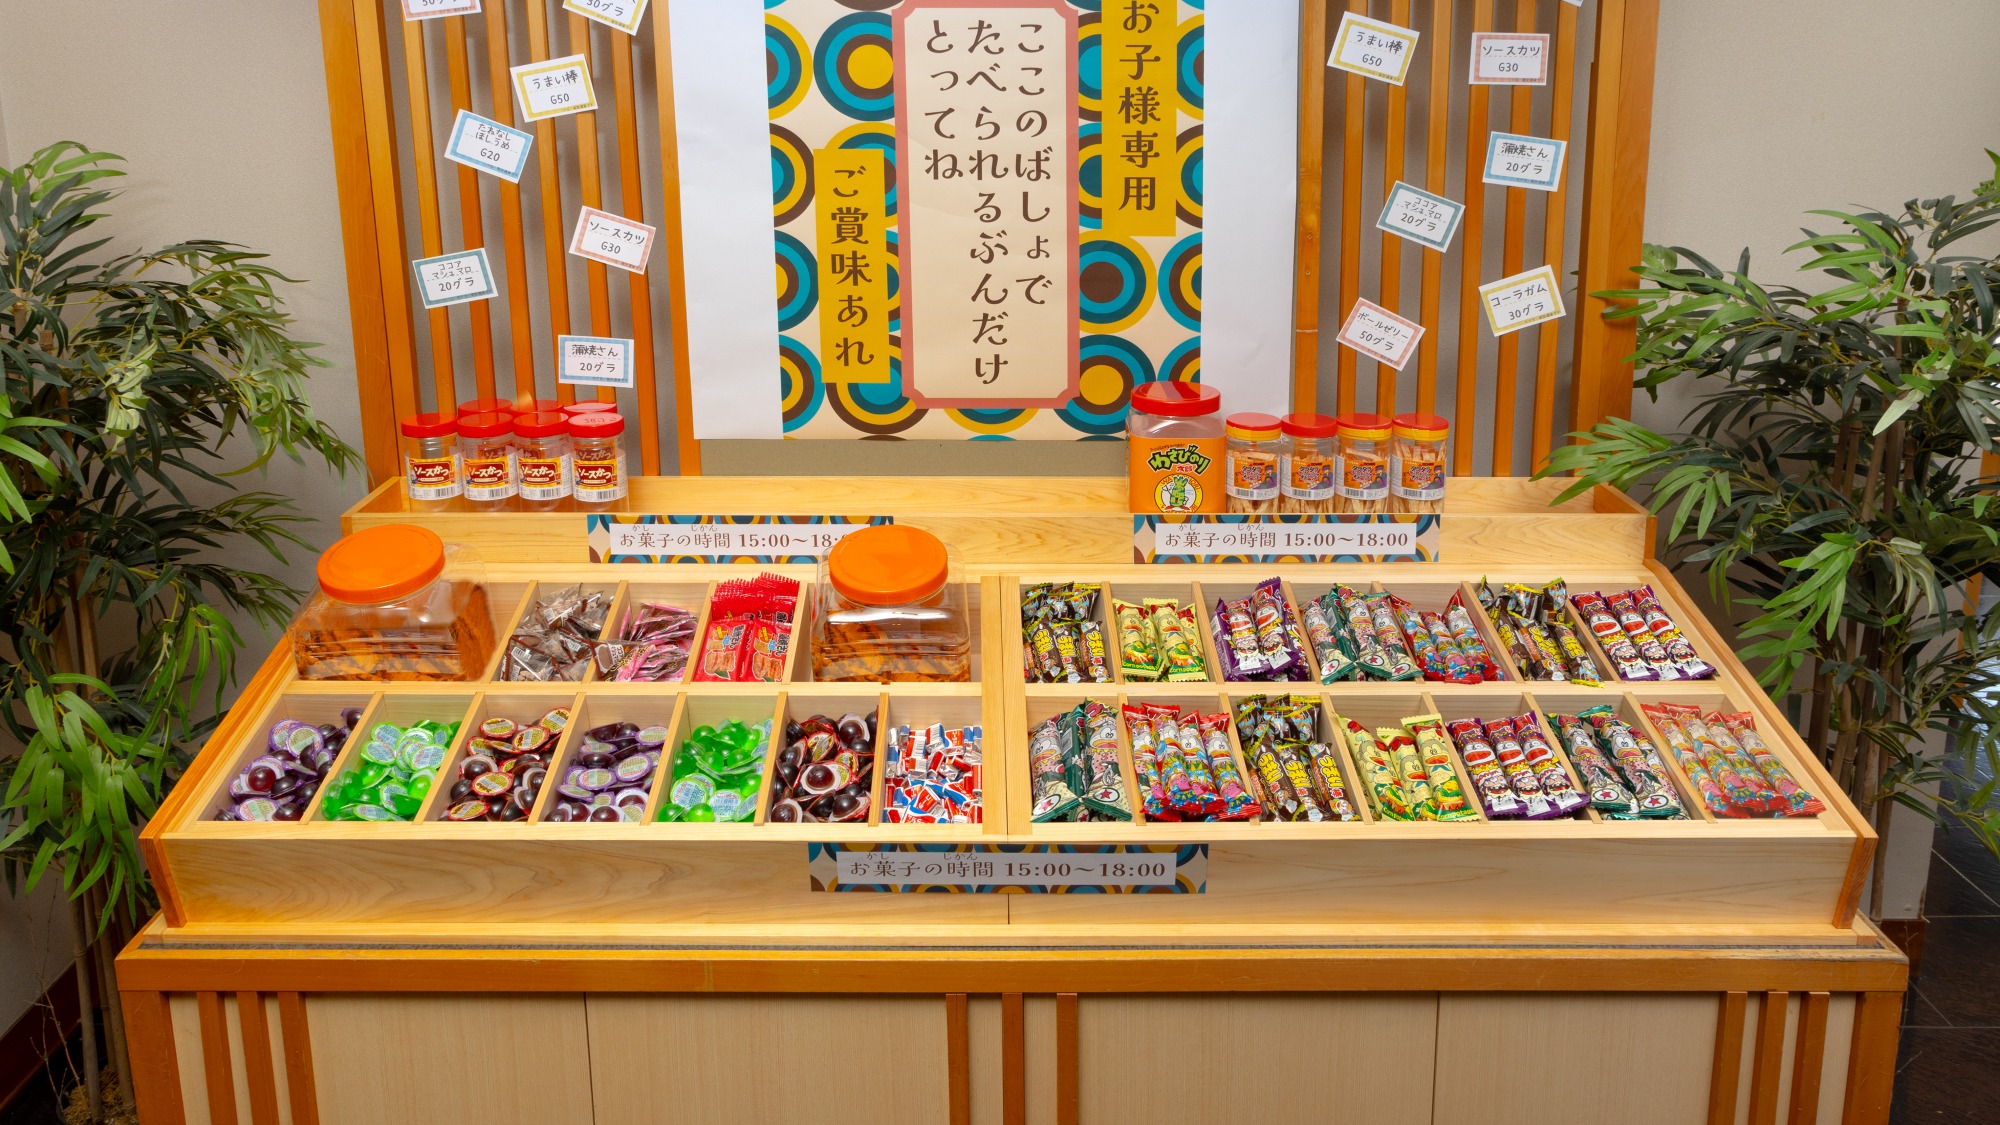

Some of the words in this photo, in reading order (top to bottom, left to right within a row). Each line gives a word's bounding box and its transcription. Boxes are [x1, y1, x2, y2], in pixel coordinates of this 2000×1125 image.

[1357, 31, 1403, 54] うまい棒
[1483, 45, 1540, 56] ソースカツ
[1362, 53, 1382, 66] G50
[1498, 62, 1519, 72] G30
[532, 69, 578, 89] うまい棒
[550, 93, 569, 104] G50
[924, 19, 963, 181] とってね
[1117, 0, 1161, 211] お子様専用
[477, 123, 511, 140] たねなし
[480, 148, 500, 161] G20
[1501, 142, 1548, 158] 蒲焼さん
[1015, 24, 1053, 305] ここのばしょで
[1506, 162, 1543, 174] 20グラ
[966, 19, 1009, 384] たべられるぶんだけ
[1400, 213, 1437, 231] 20グラ
[590, 221, 645, 244] ソースカツ
[601, 241, 621, 254] G30
[830, 165, 874, 367] ご賞味あれ
[439, 277, 474, 291] 20グラ
[1490, 283, 1547, 307] コーラガム
[1508, 302, 1544, 320] 30グラ
[1359, 330, 1394, 350] 50グラ
[571, 344, 619, 357] 蒲焼さん
[579, 361, 616, 373] 20グラ
[1148, 444, 1211, 475] わさびのり
[414, 465, 449, 477] ソースかつ
[468, 465, 503, 477] ソースかつ
[521, 465, 555, 477] ソースかつ
[578, 467, 612, 479] ソースかつ
[620, 532, 731, 549] お菓子の時間
[1165, 531, 1276, 548] お菓子の時間
[850, 860, 994, 878] お菓子の時間
